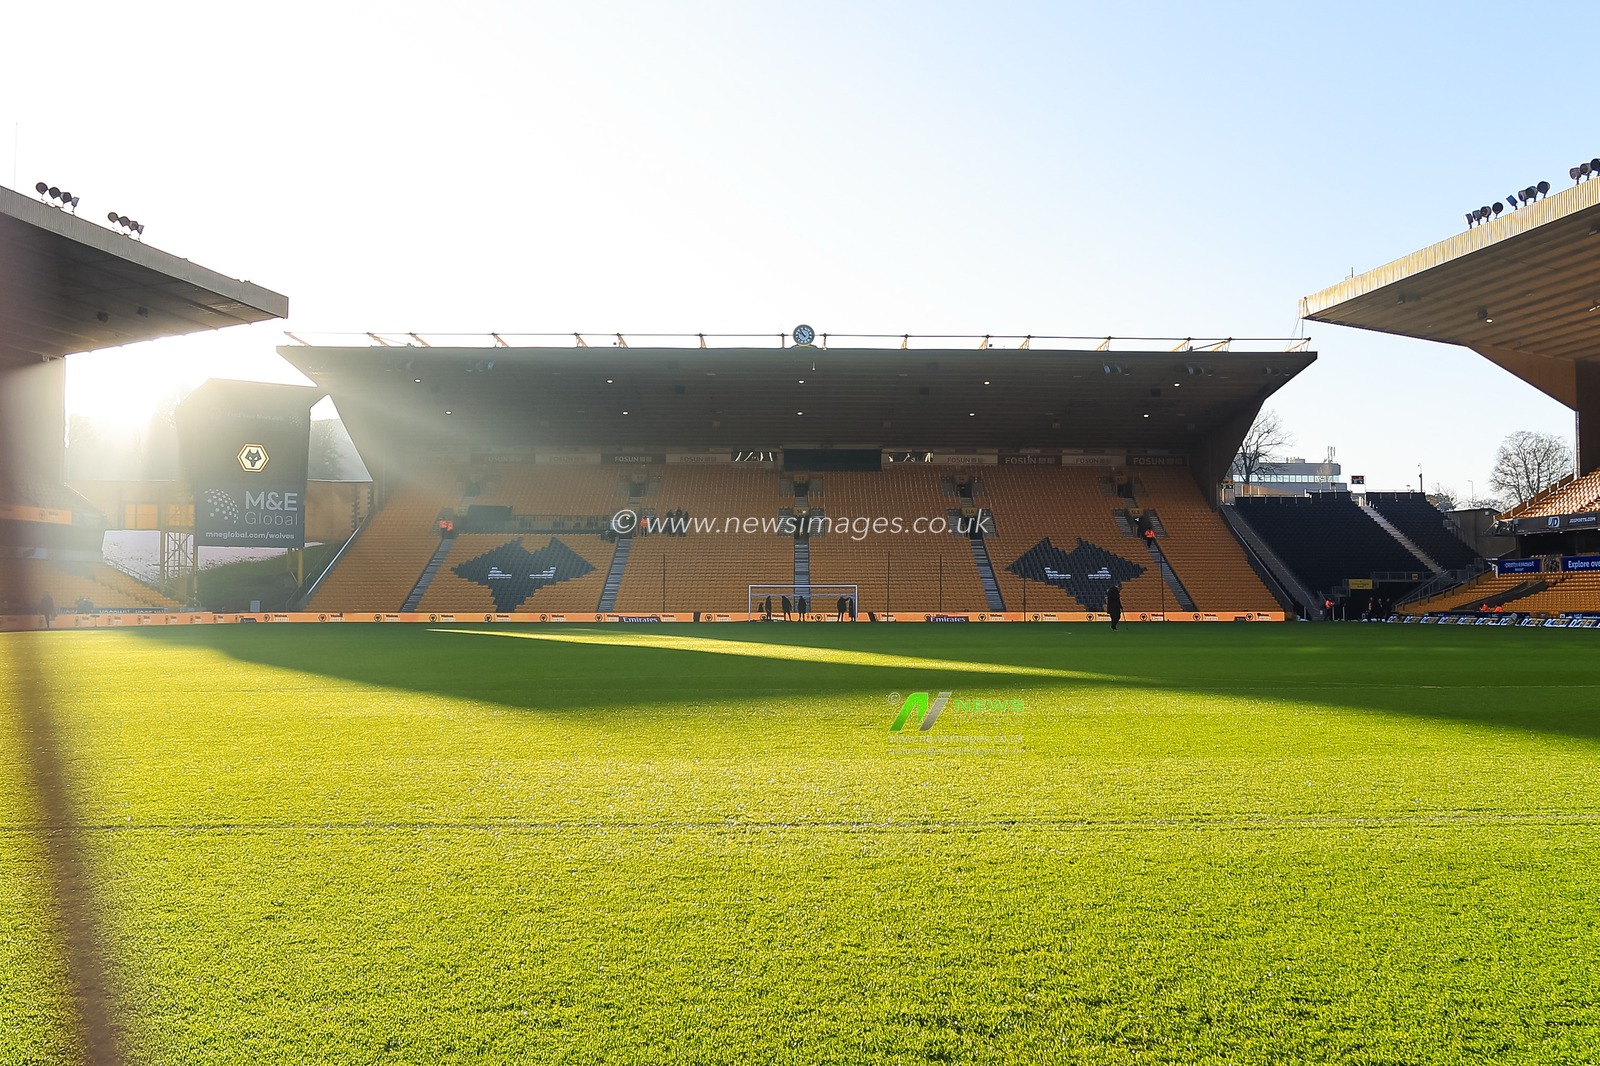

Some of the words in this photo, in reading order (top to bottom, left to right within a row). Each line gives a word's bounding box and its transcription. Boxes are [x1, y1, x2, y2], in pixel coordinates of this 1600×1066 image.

[614, 455, 639, 463] FOSUN
[946, 456, 970, 464] FOSUN
[1005, 456, 1037, 464] FOSUN
[1133, 457, 1165, 465] FOSUN
[245, 490, 298, 511] M&E
[244, 511, 298, 526] Global
[205, 530, 295, 540] mneglobal.com/wolves
[1567, 559, 1590, 570] Explore
